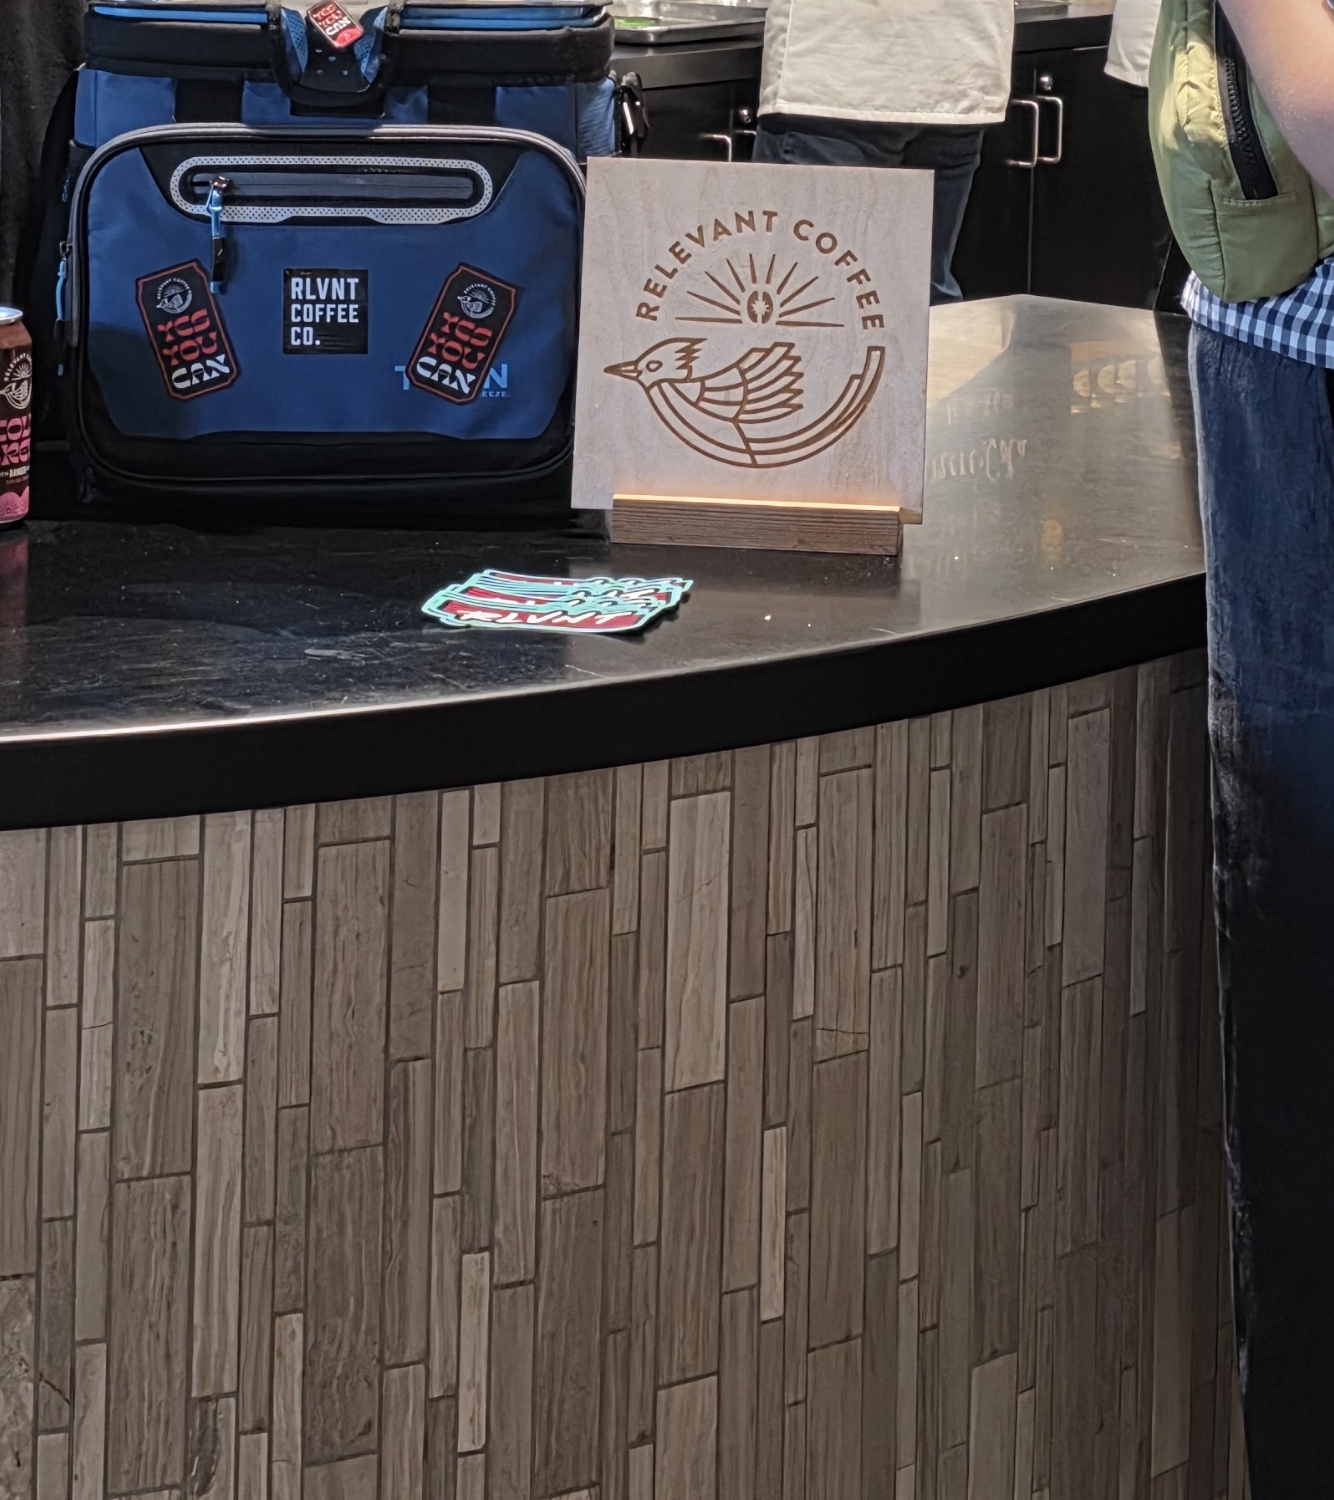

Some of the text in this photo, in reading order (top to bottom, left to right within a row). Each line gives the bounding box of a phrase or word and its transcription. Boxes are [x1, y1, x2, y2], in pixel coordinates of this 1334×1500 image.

[326, 16, 351, 35] CAN
[635, 209, 886, 331] RELEVANT COFFEE
[291, 277, 359, 300] RLVNT
[157, 308, 210, 342] YES
[291, 304, 359, 323] COFFEE
[440, 312, 492, 347] YES
[162, 331, 218, 366] YOU
[291, 326, 320, 346] CO.
[427, 332, 485, 370] YOU
[171, 354, 230, 389] CAN
[416, 356, 476, 394] CAN
[456, 610, 638, 624] RLVNT
